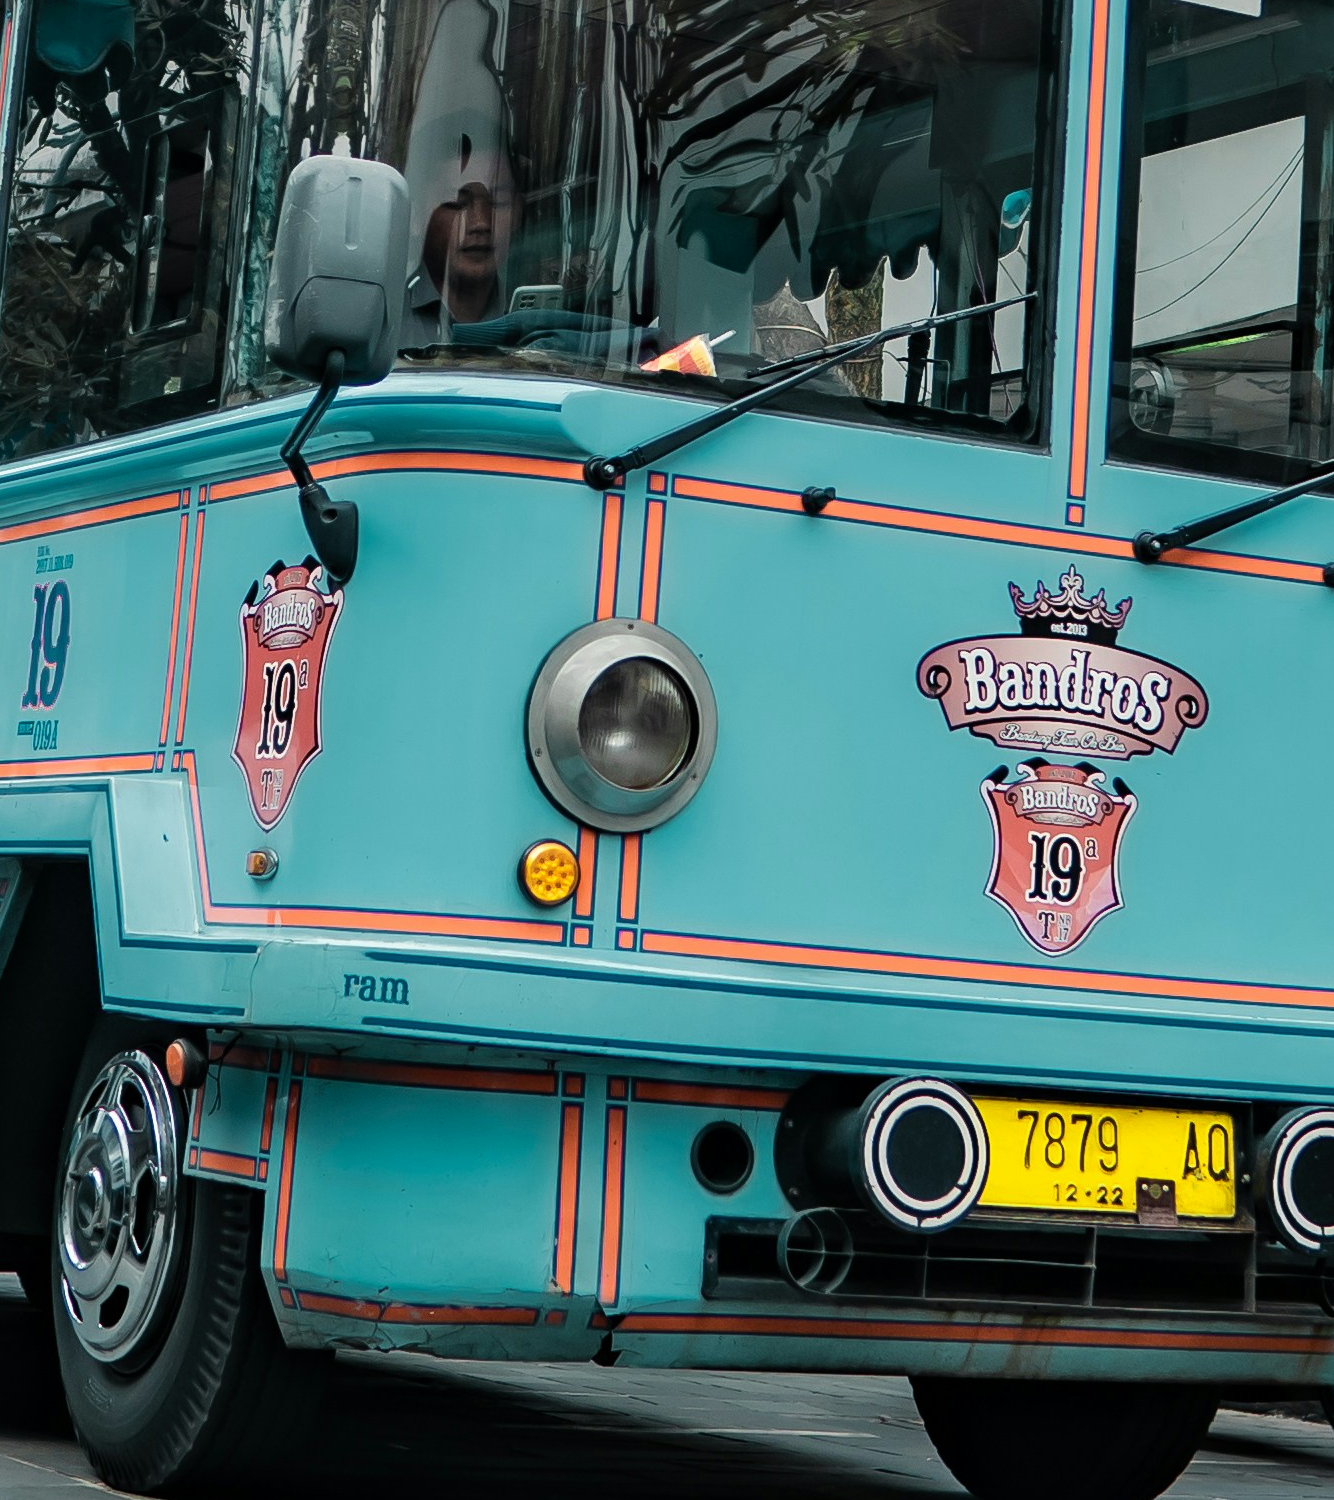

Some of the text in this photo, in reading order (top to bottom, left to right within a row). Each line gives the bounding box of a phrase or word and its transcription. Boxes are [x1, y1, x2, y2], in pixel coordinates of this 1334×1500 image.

[22, 580, 71, 710] 19
[263, 593, 316, 634] Bandros
[256, 660, 297, 758] 19
[959, 647, 1172, 735] Bandros
[999, 723, 1127, 752] Bandung Tour On Bus
[1020, 785, 1099, 818] Bandros
[1027, 832, 1084, 905] 19
[343, 973, 410, 1006] ram
[1017, 1109, 1118, 1173] 7879
